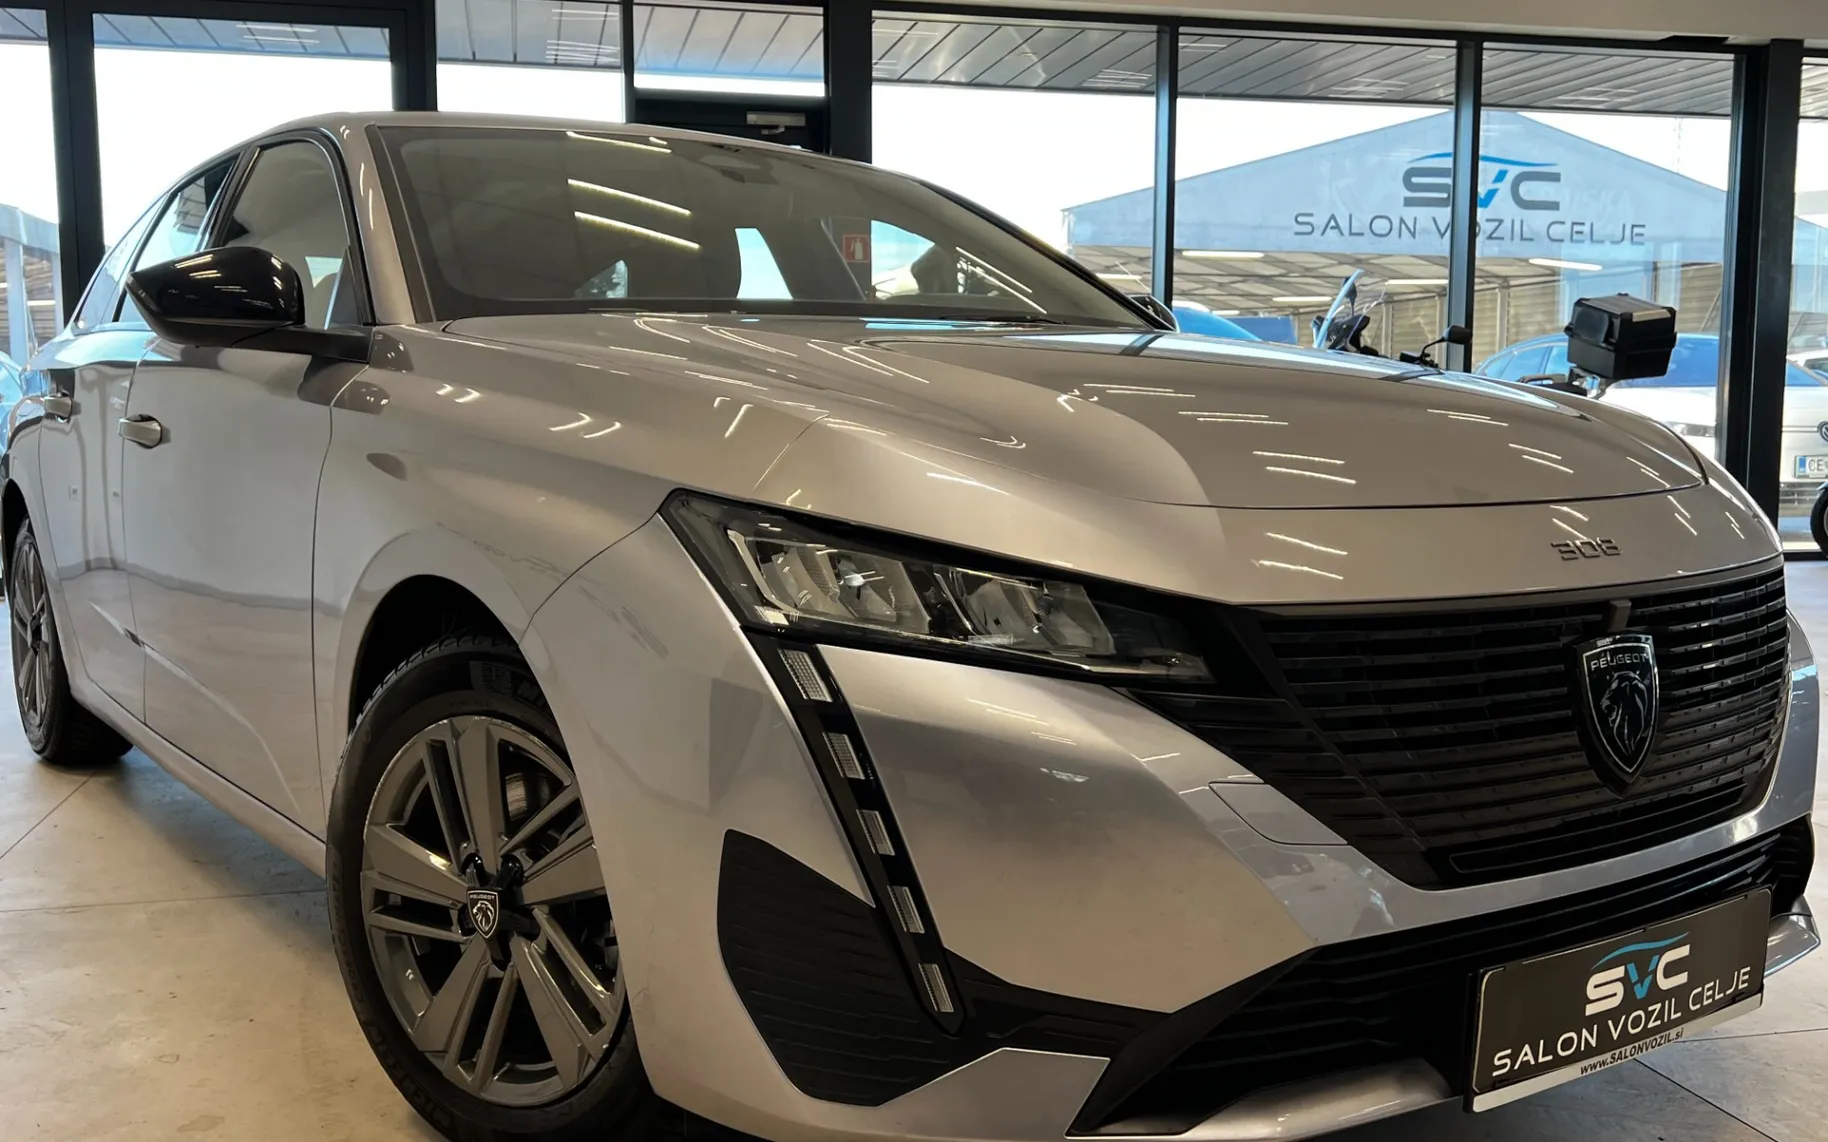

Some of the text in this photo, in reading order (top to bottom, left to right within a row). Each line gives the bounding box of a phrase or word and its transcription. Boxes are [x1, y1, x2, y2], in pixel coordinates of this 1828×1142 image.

[1294, 213, 1646, 245] SALON VZIL CELJE
[1551, 537, 1622, 561] 308
[1591, 653, 1647, 671] PEUGEOT
[1585, 944, 1690, 1016] SVC
[1492, 966, 1751, 1077] SALON VOZIL CELJE
[1580, 1028, 1684, 1075] www.SALONVOZIL.si
